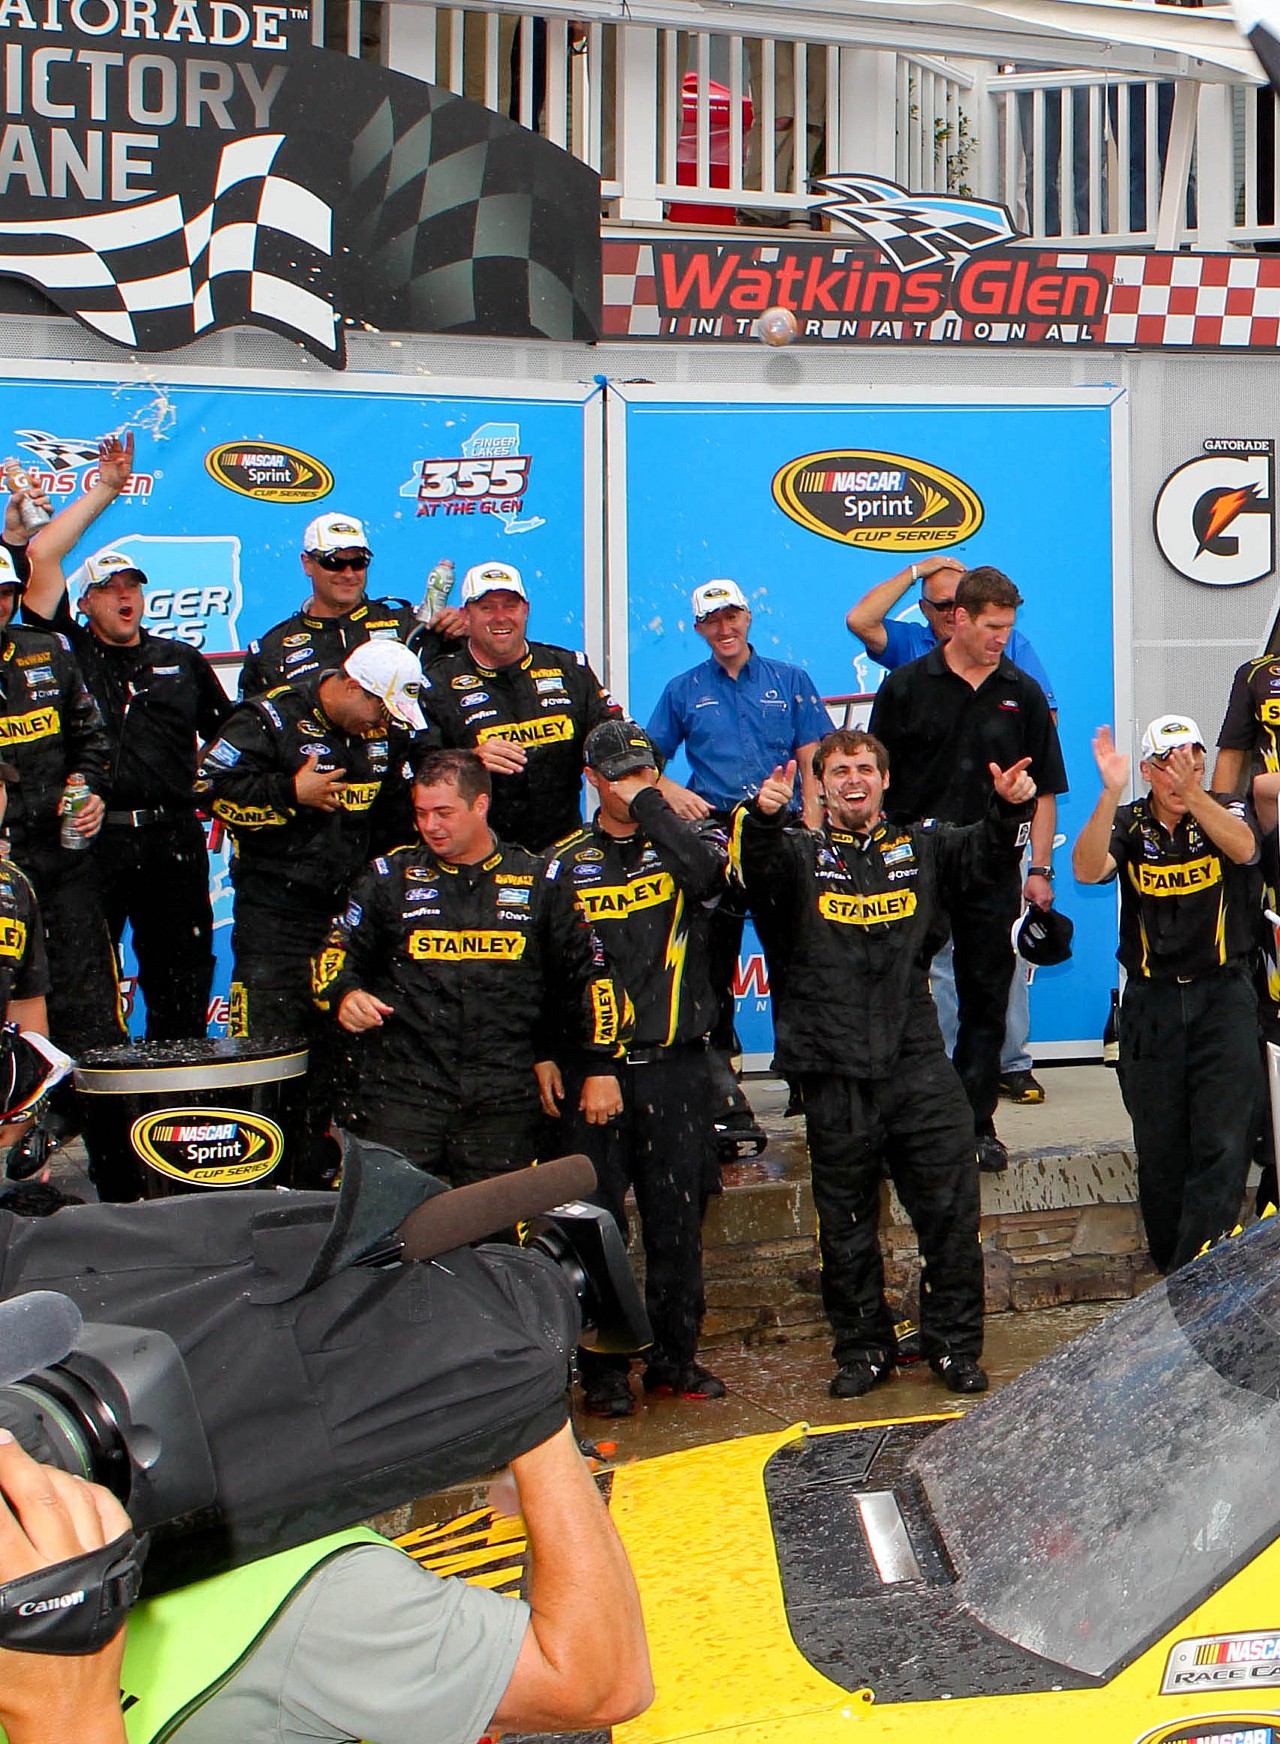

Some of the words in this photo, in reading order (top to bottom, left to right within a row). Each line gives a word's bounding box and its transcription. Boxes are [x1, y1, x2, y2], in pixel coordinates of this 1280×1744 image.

[6, 43, 289, 131] ICTORY
[0, 124, 160, 201] ANE
[661, 253, 943, 313] Watkins
[958, 259, 1100, 316] Glen
[668, 316, 1093, 341] INTRNATIONAL
[471, 447, 511, 457] LAKES
[473, 437, 517, 448] FINGER
[1204, 440, 1270, 451] GATORADE
[243, 453, 284, 468] NASCAR
[248, 467, 292, 484] Sprint
[420, 457, 530, 500] 355
[832, 471, 902, 492] NASCAR
[253, 488, 275, 498] CUP
[277, 489, 319, 498] SERIES
[416, 503, 440, 518] AT
[443, 501, 477, 516] THE
[479, 500, 524, 514] GLEN
[844, 496, 914, 522] Sprint
[1156, 455, 1272, 585] G
[853, 531, 891, 542] CUP
[894, 530, 959, 541] SERIES
[1142, 861, 1212, 890] STANLEY
[828, 896, 908, 918] STANLEY
[418, 936, 518, 953] STANLEY
[178, 1124, 232, 1142] NASCAR
[187, 1142, 242, 1164] Sprint
[193, 1169, 225, 1179] CUP
[227, 1163, 270, 1177] SERIES
[18, 1590, 85, 1616] Canon
[1174, 1669, 1245, 1684] RACE
